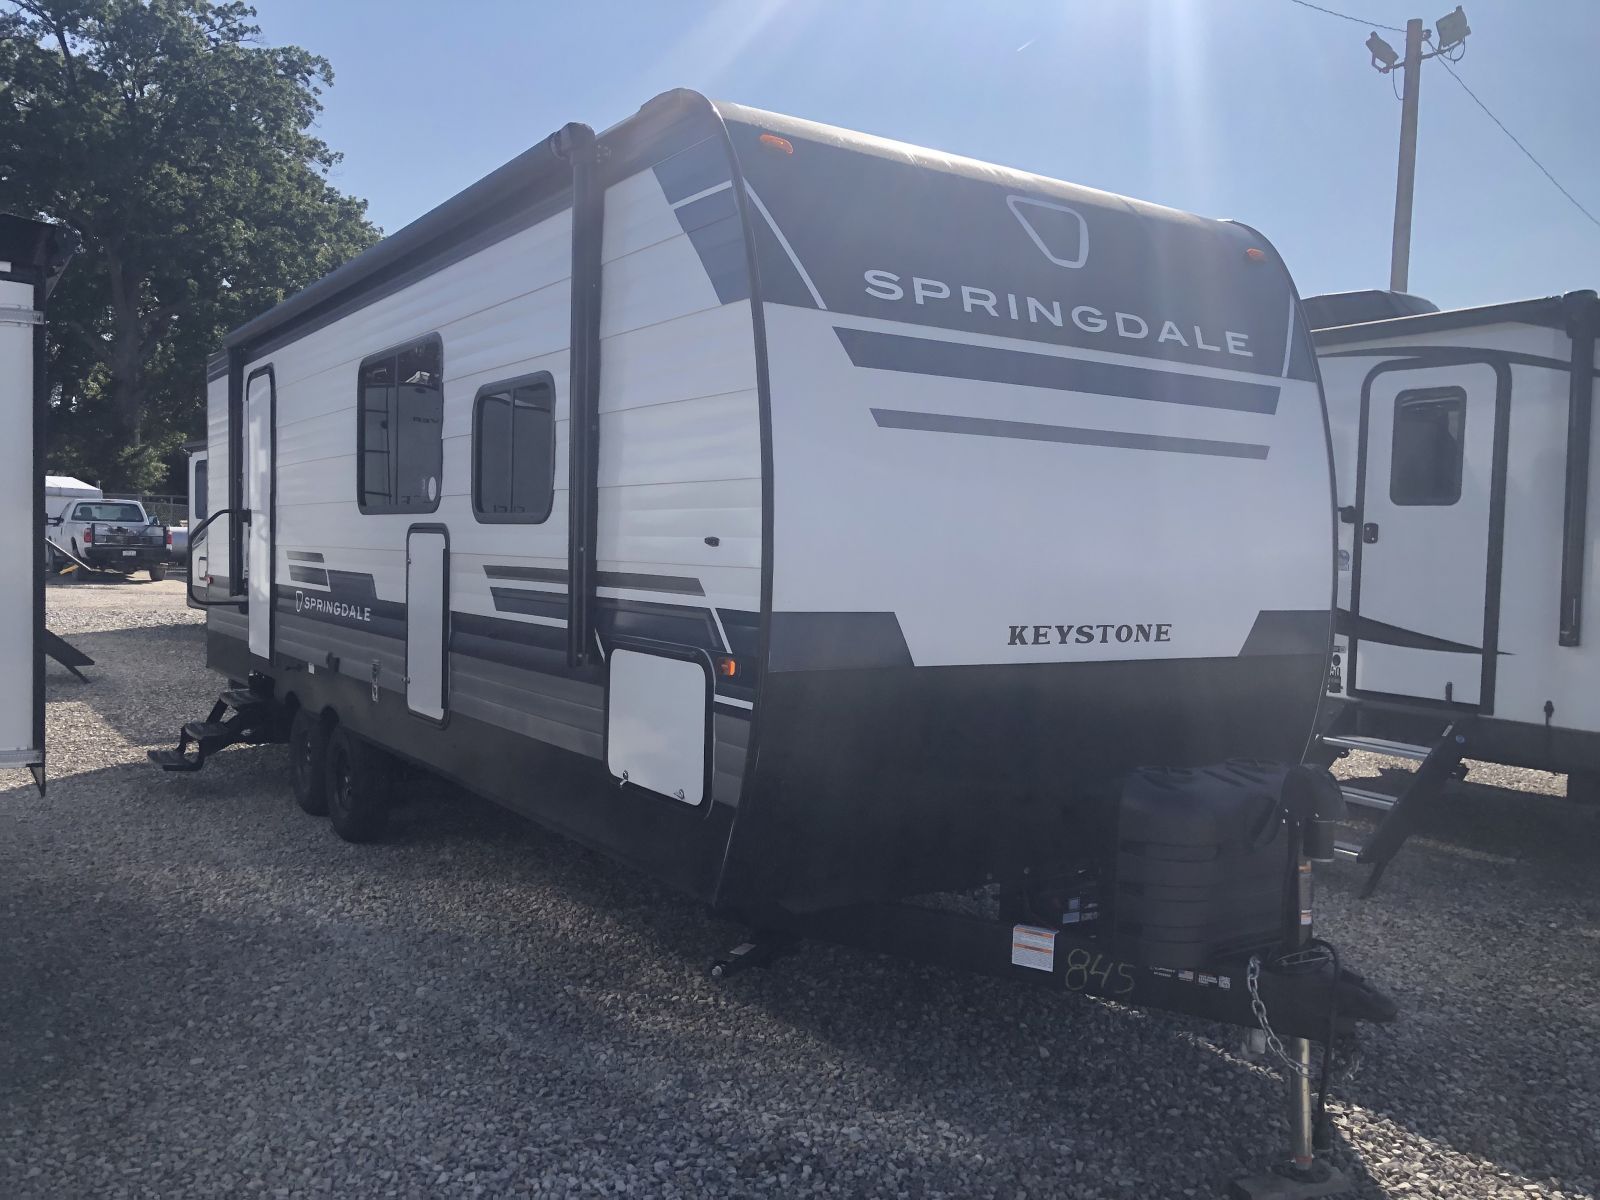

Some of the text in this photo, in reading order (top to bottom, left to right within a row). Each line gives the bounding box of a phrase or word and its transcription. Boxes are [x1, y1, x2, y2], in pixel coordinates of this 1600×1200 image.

[864, 269, 1254, 358] SPRINGDALE
[304, 597, 372, 622] SPRINGDALE
[1007, 623, 1173, 645] KEYSTONE
[1065, 948, 1137, 994] 845
